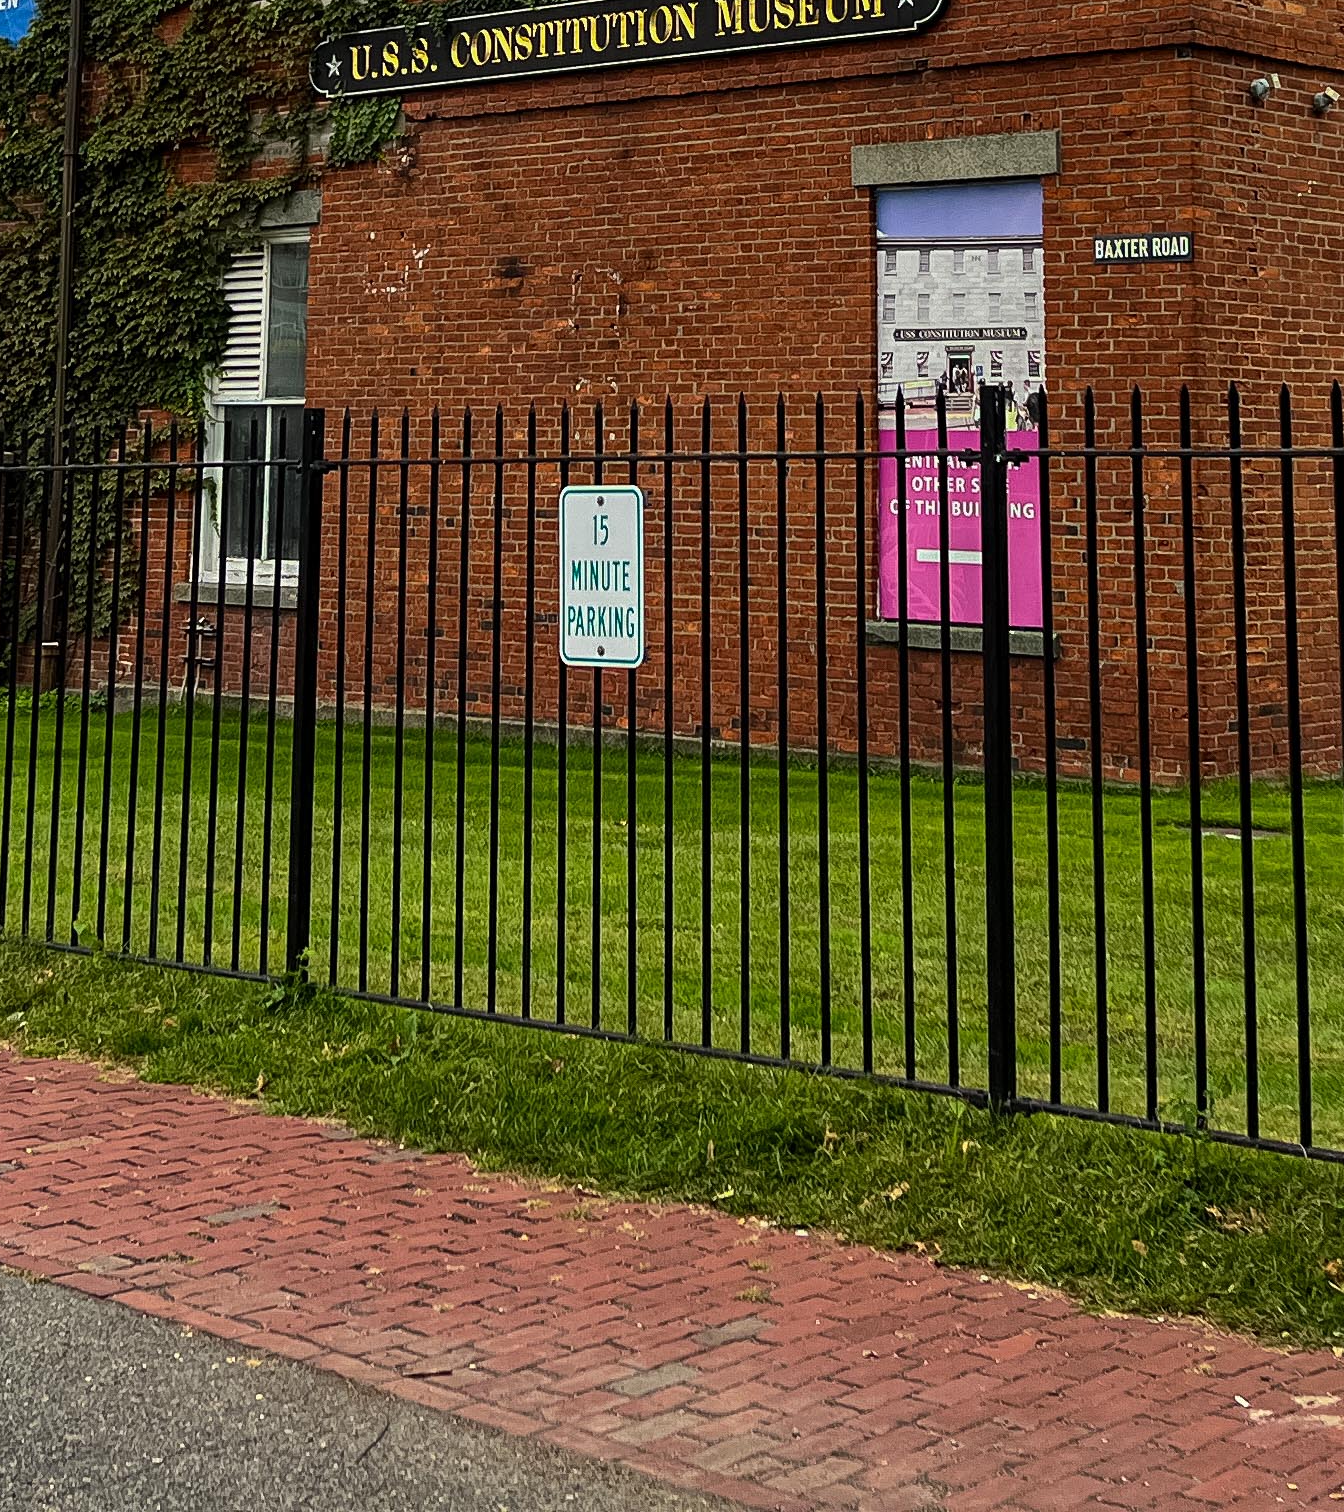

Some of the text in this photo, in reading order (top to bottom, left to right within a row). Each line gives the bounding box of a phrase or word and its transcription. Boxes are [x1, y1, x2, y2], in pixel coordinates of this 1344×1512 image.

[349, 37, 439, 80] U.S.S.
[450, 1, 699, 68] CONSTITUTION
[1094, 236, 1189, 259] BAXTER ROAD
[900, 327, 1021, 339] USS CONSTITUTION MUSEUM
[914, 499, 941, 516] TH
[951, 501, 1035, 519] BUING
[592, 514, 609, 546] 15
[571, 560, 631, 592] MINUTE
[567, 605, 635, 639] PARKING
